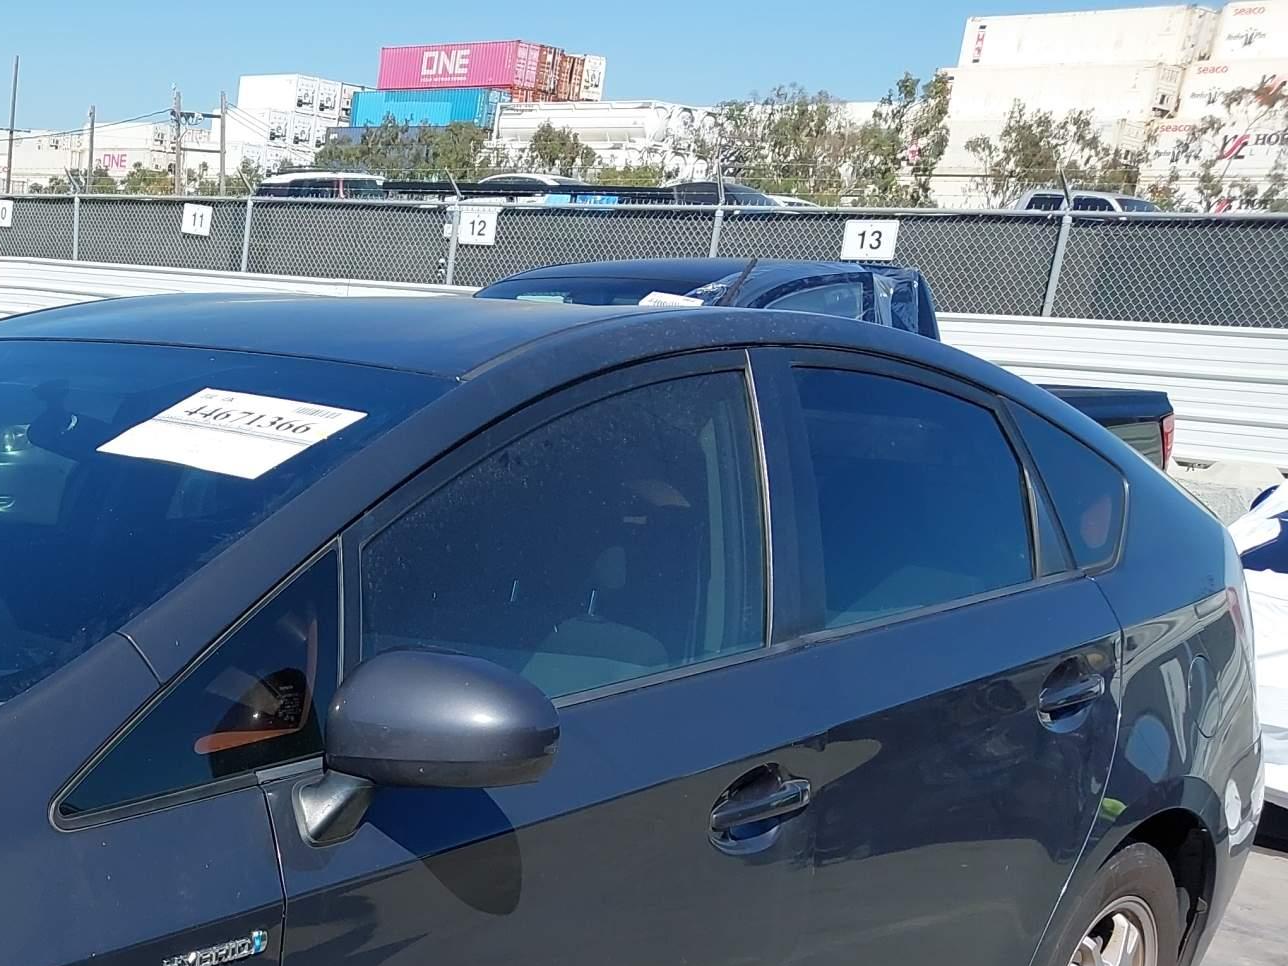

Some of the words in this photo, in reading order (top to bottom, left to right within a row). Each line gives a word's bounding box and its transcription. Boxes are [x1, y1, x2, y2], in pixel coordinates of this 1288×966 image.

[1232, 6, 1266, 16] seaco
[420, 48, 471, 75] ONE
[1196, 65, 1229, 75] seaco
[1159, 123, 1192, 133] seaco
[102, 153, 128, 169] ONE
[191, 212, 205, 229] 11
[469, 220, 487, 237] 12
[857, 230, 882, 250] 13
[184, 404, 316, 434] 44671366
